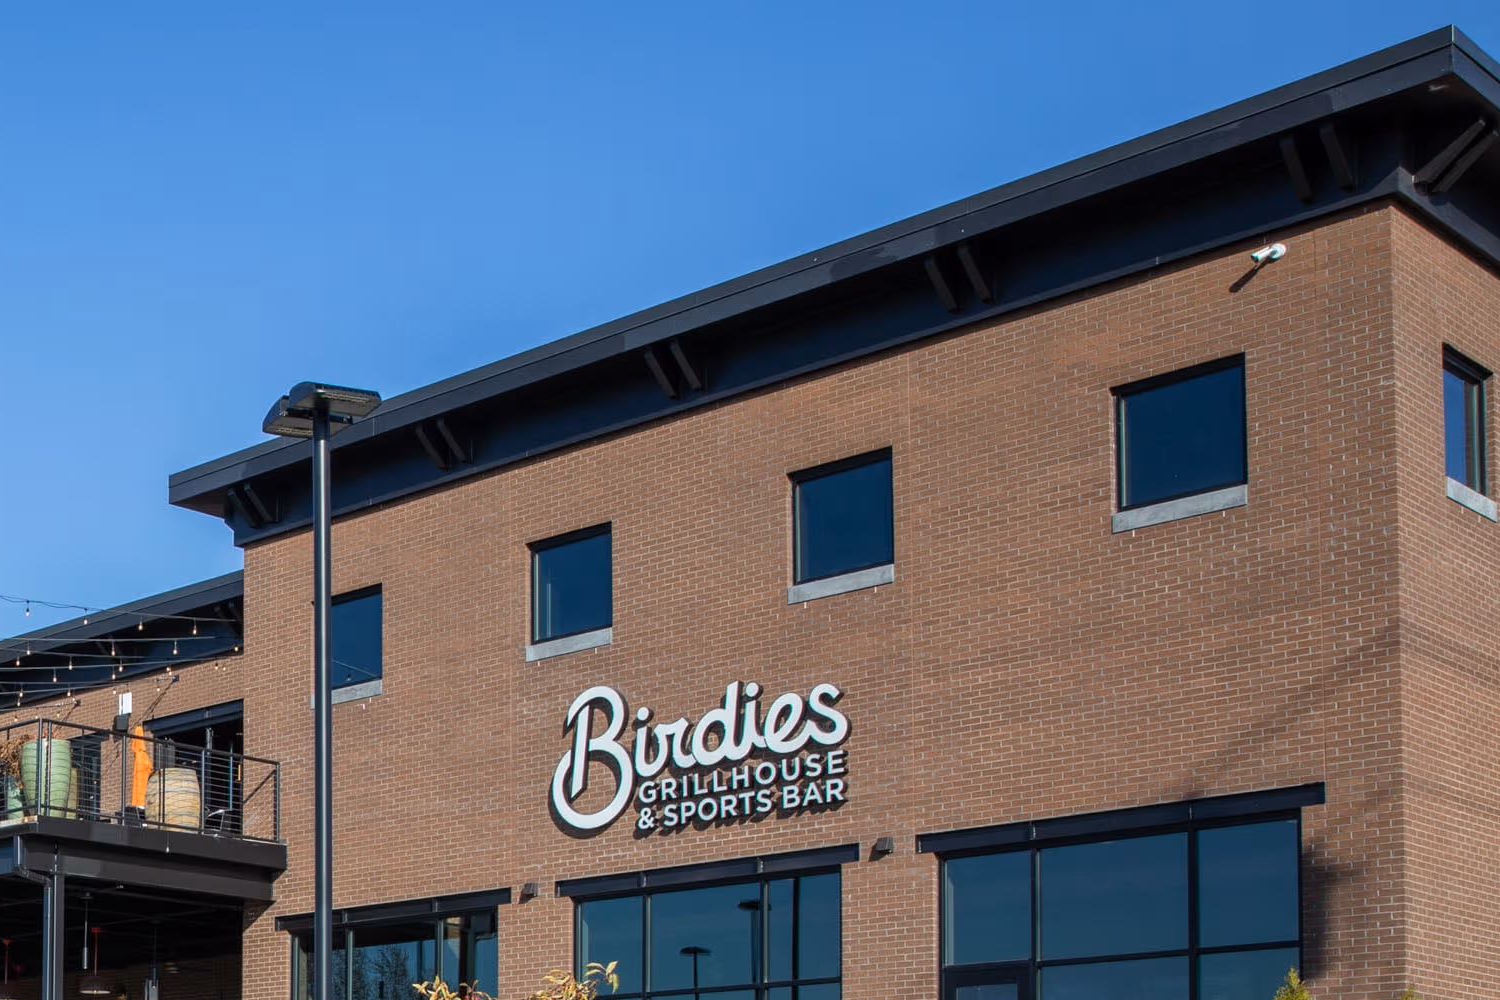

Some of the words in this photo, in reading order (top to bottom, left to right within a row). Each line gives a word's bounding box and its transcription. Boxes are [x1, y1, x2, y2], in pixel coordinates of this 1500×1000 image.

[552, 681, 849, 830] Birdies
[638, 750, 846, 804] GRILLHOUSE
[637, 807, 655, 830] &
[663, 788, 773, 827] SPORTS
[782, 778, 845, 809] BAR
